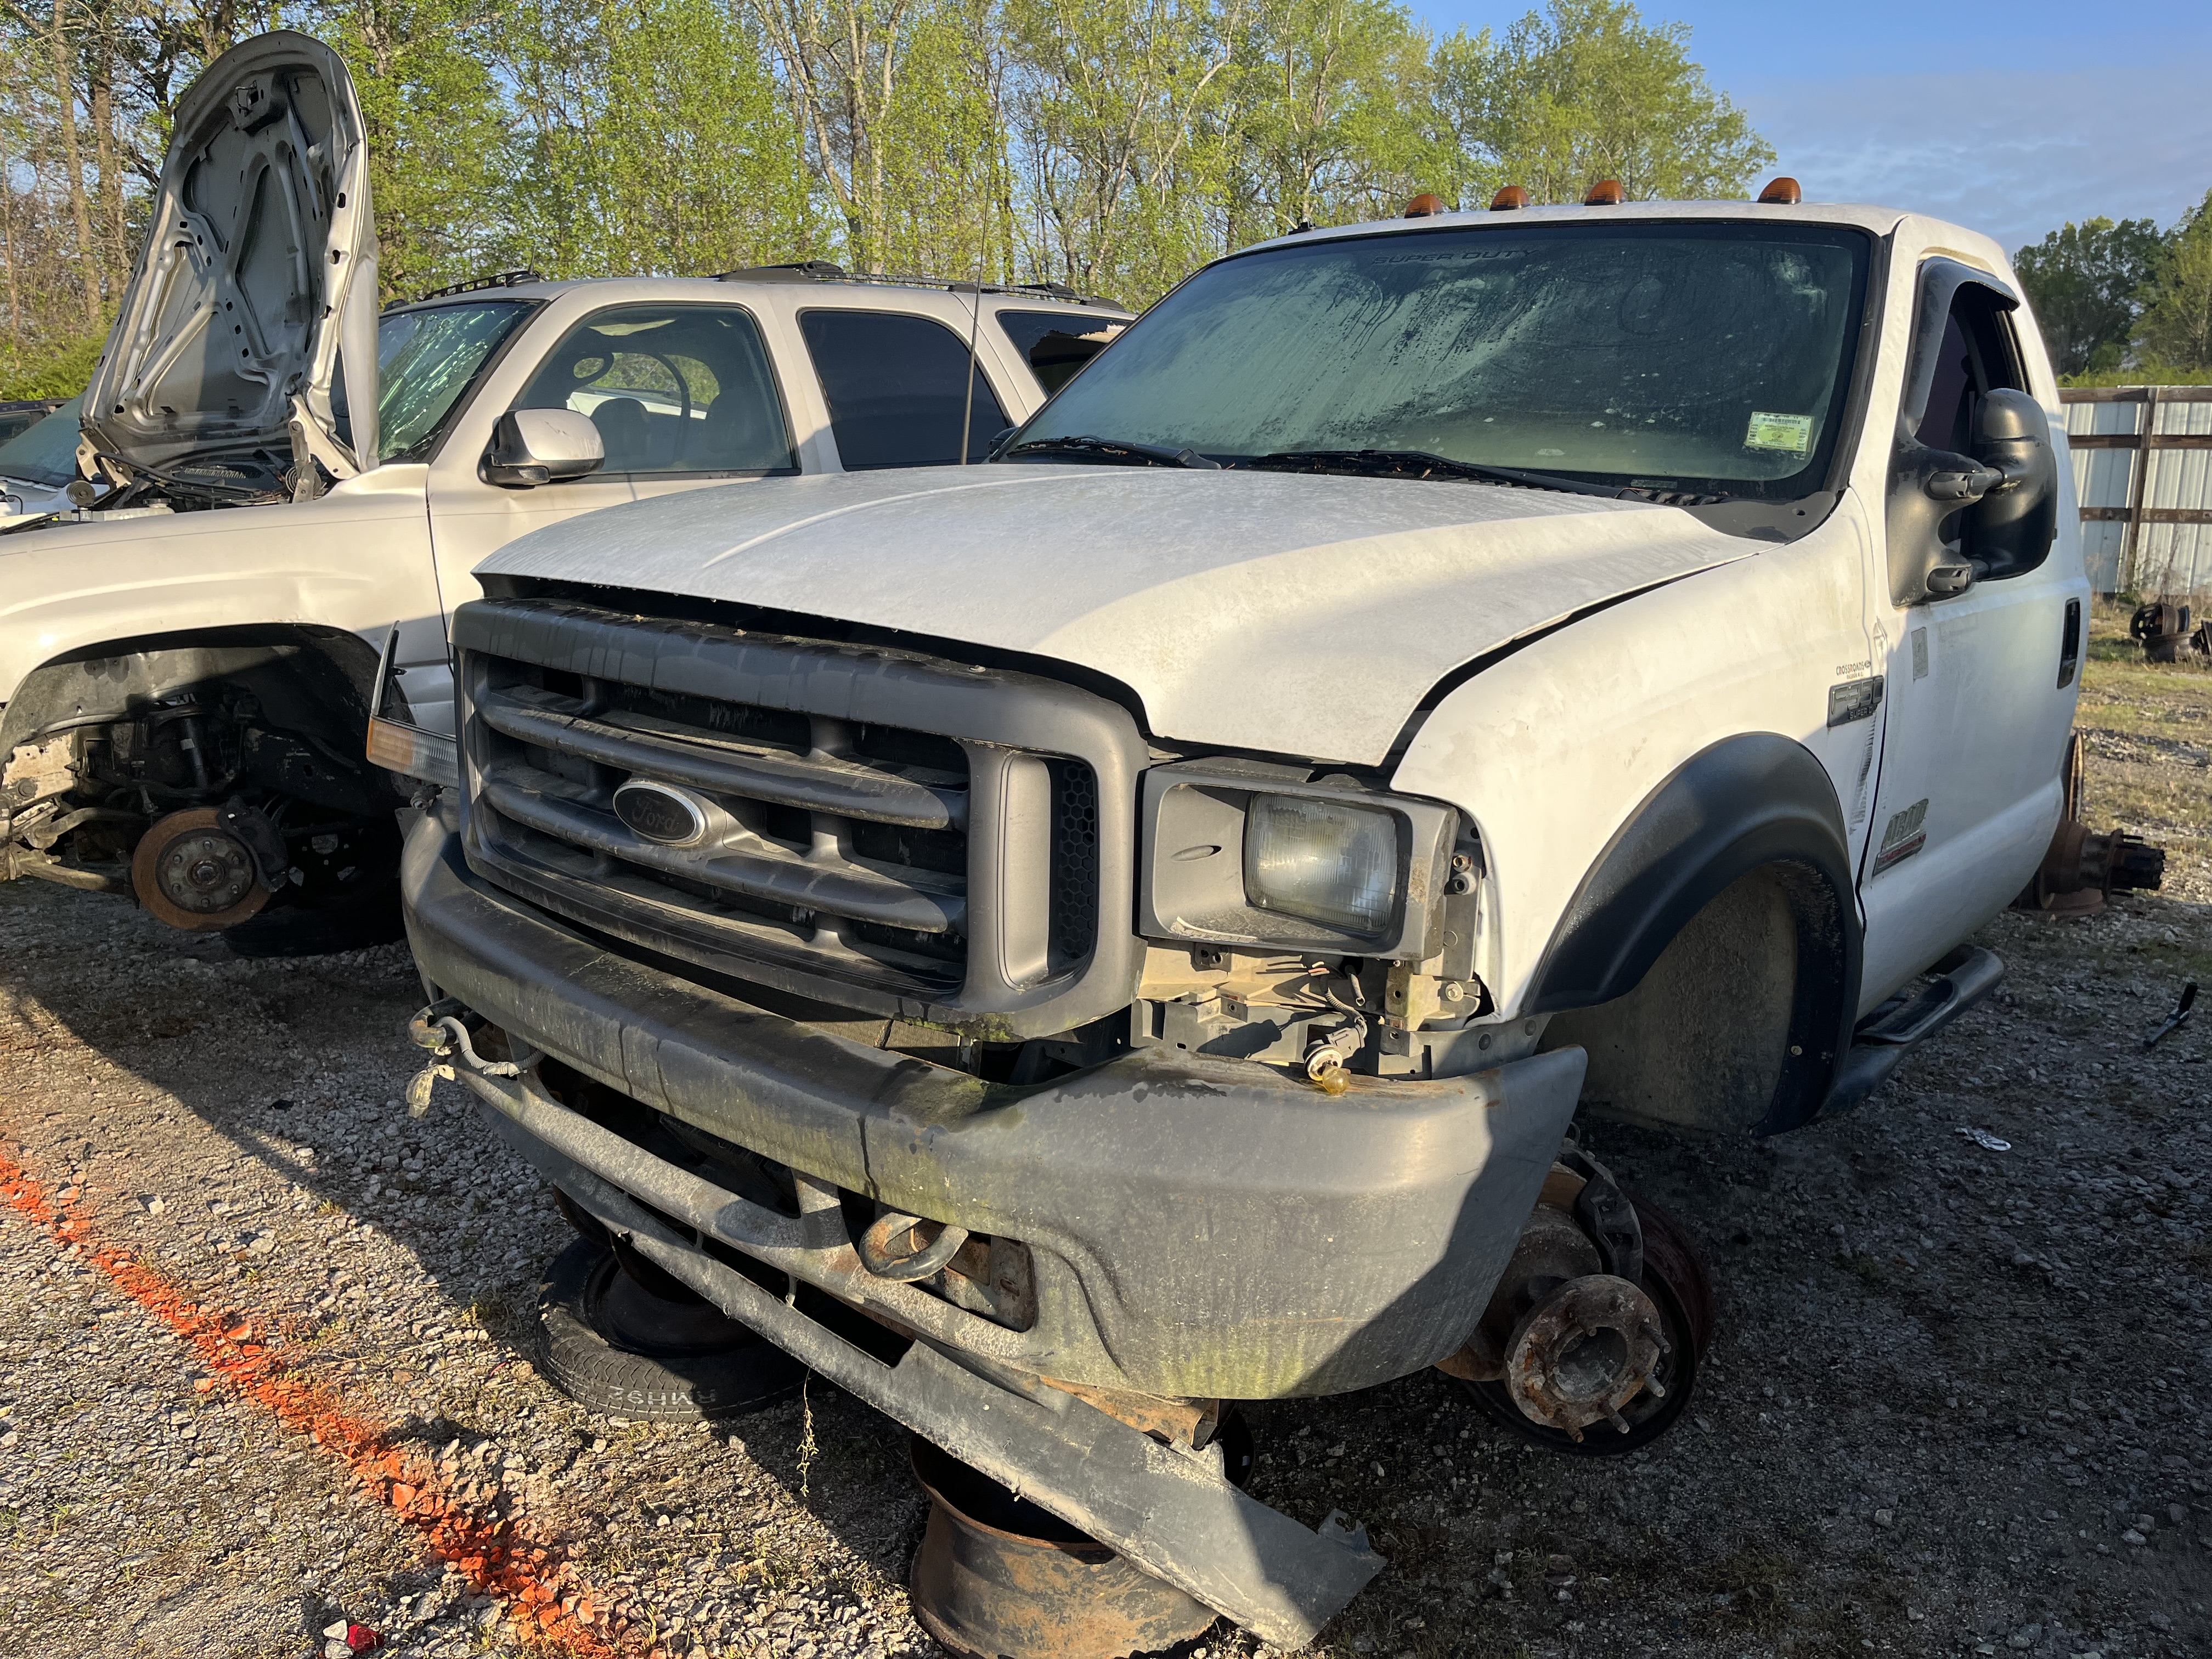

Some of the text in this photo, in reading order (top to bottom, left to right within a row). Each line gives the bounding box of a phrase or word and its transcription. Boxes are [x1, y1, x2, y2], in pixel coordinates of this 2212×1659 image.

[1372, 250, 1539, 264] SUPER DUTY
[1836, 661, 1864, 676] CROSSROADS
[1849, 707, 1868, 719] SUPER
[632, 795, 679, 833] Ford
